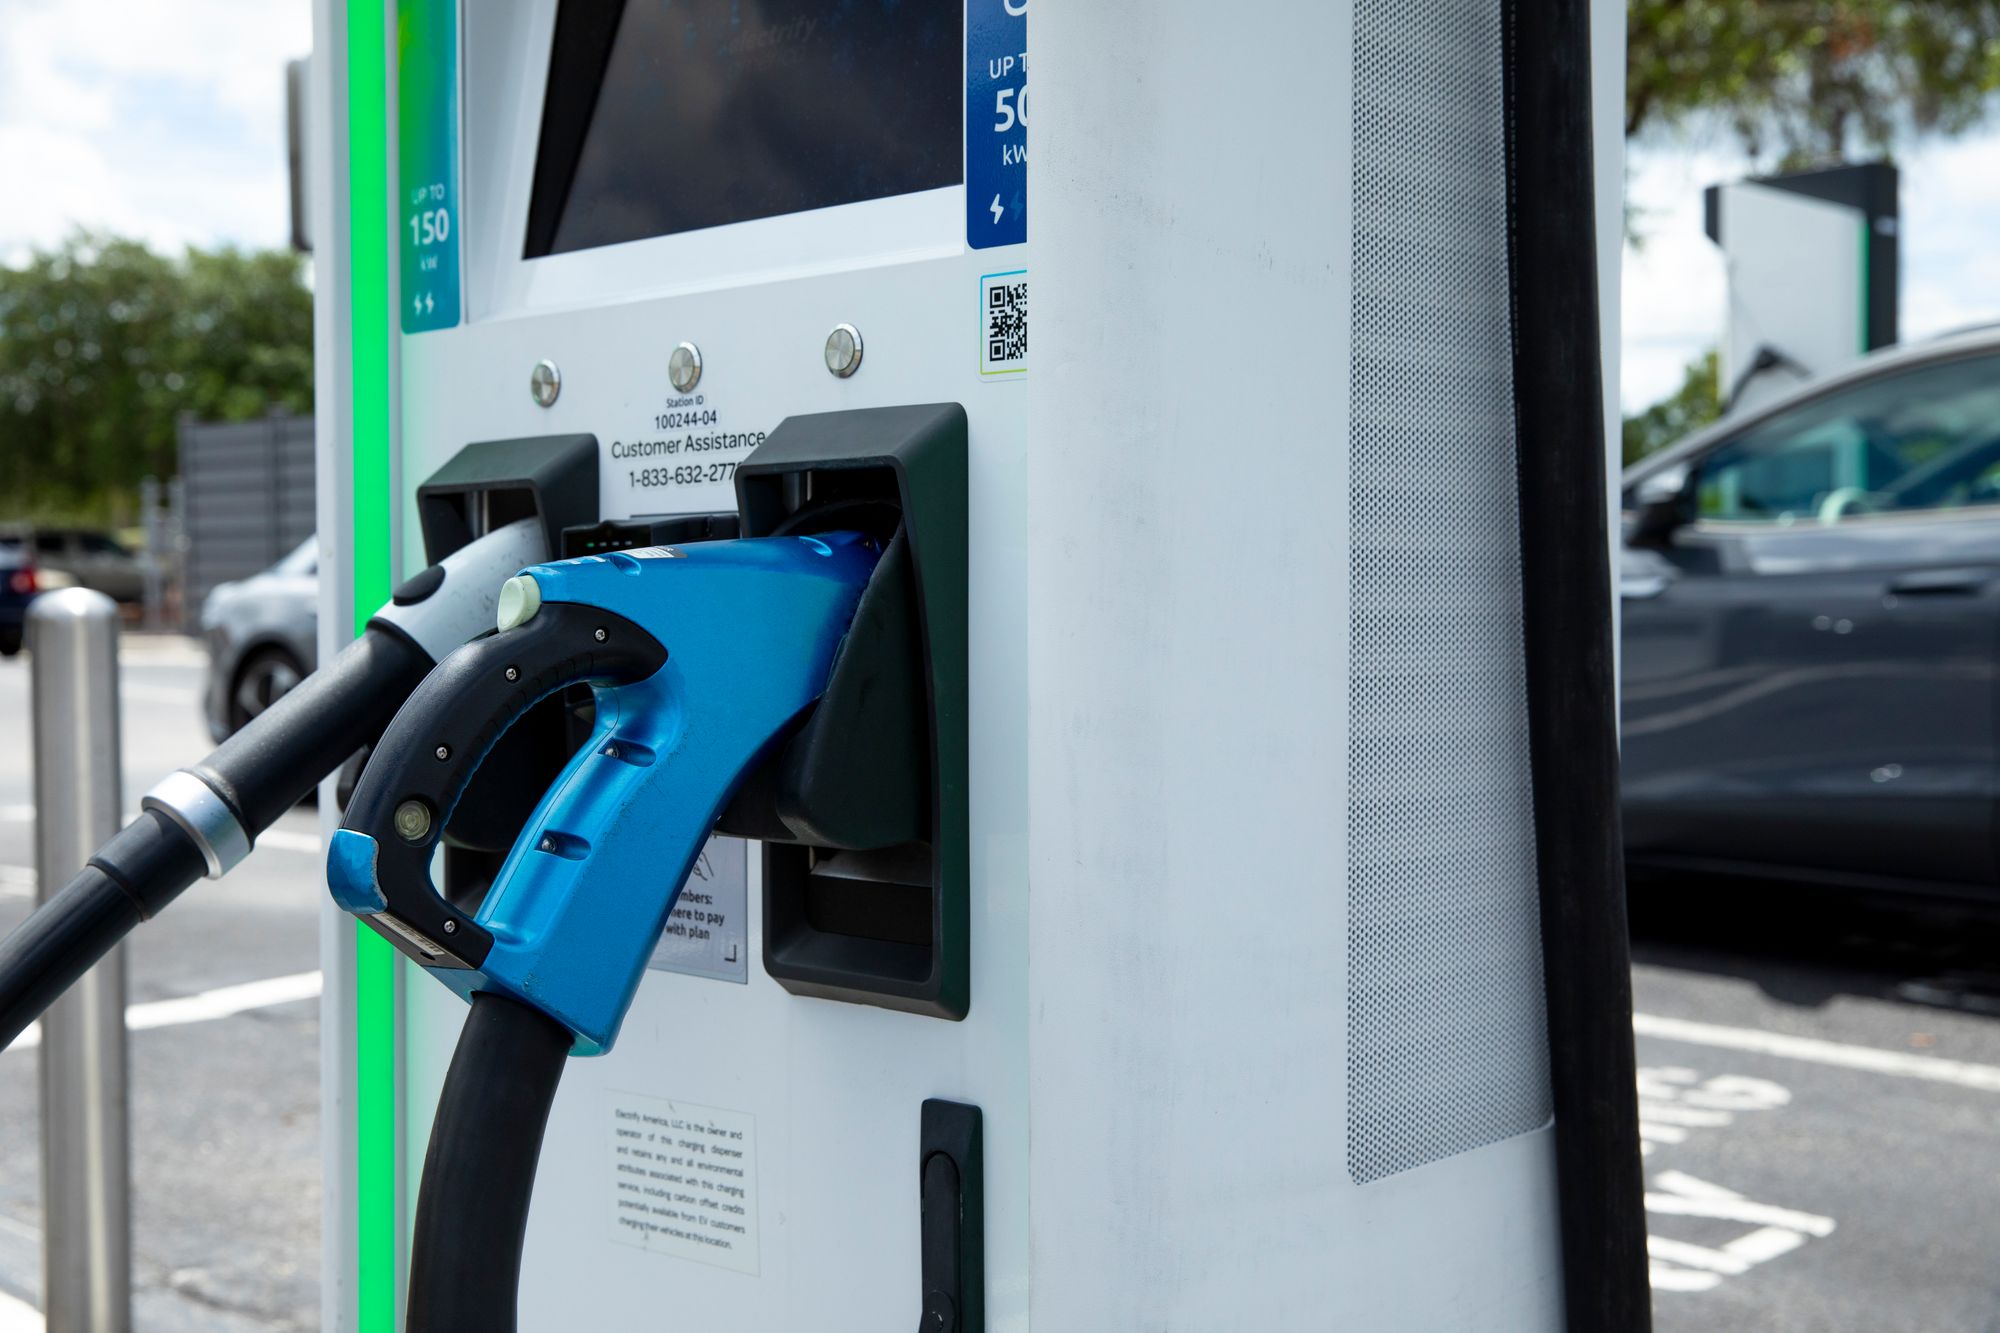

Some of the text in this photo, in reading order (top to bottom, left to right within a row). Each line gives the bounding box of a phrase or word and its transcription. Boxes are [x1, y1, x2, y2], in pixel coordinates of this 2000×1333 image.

[989, 52, 1028, 79] UP T
[1003, 143, 1028, 167] kW
[430, 182, 445, 201] TO
[410, 207, 449, 246] 150
[666, 394, 705, 409] Station ID
[655, 409, 717, 430] 100244-04
[611, 431, 766, 459] Customer Assistance
[629, 462, 742, 488] 1-833-632-277
[680, 889, 713, 905] mbers:
[694, 909, 705, 922] to
[707, 912, 725, 927] pay
[666, 922, 710, 940] with plan
